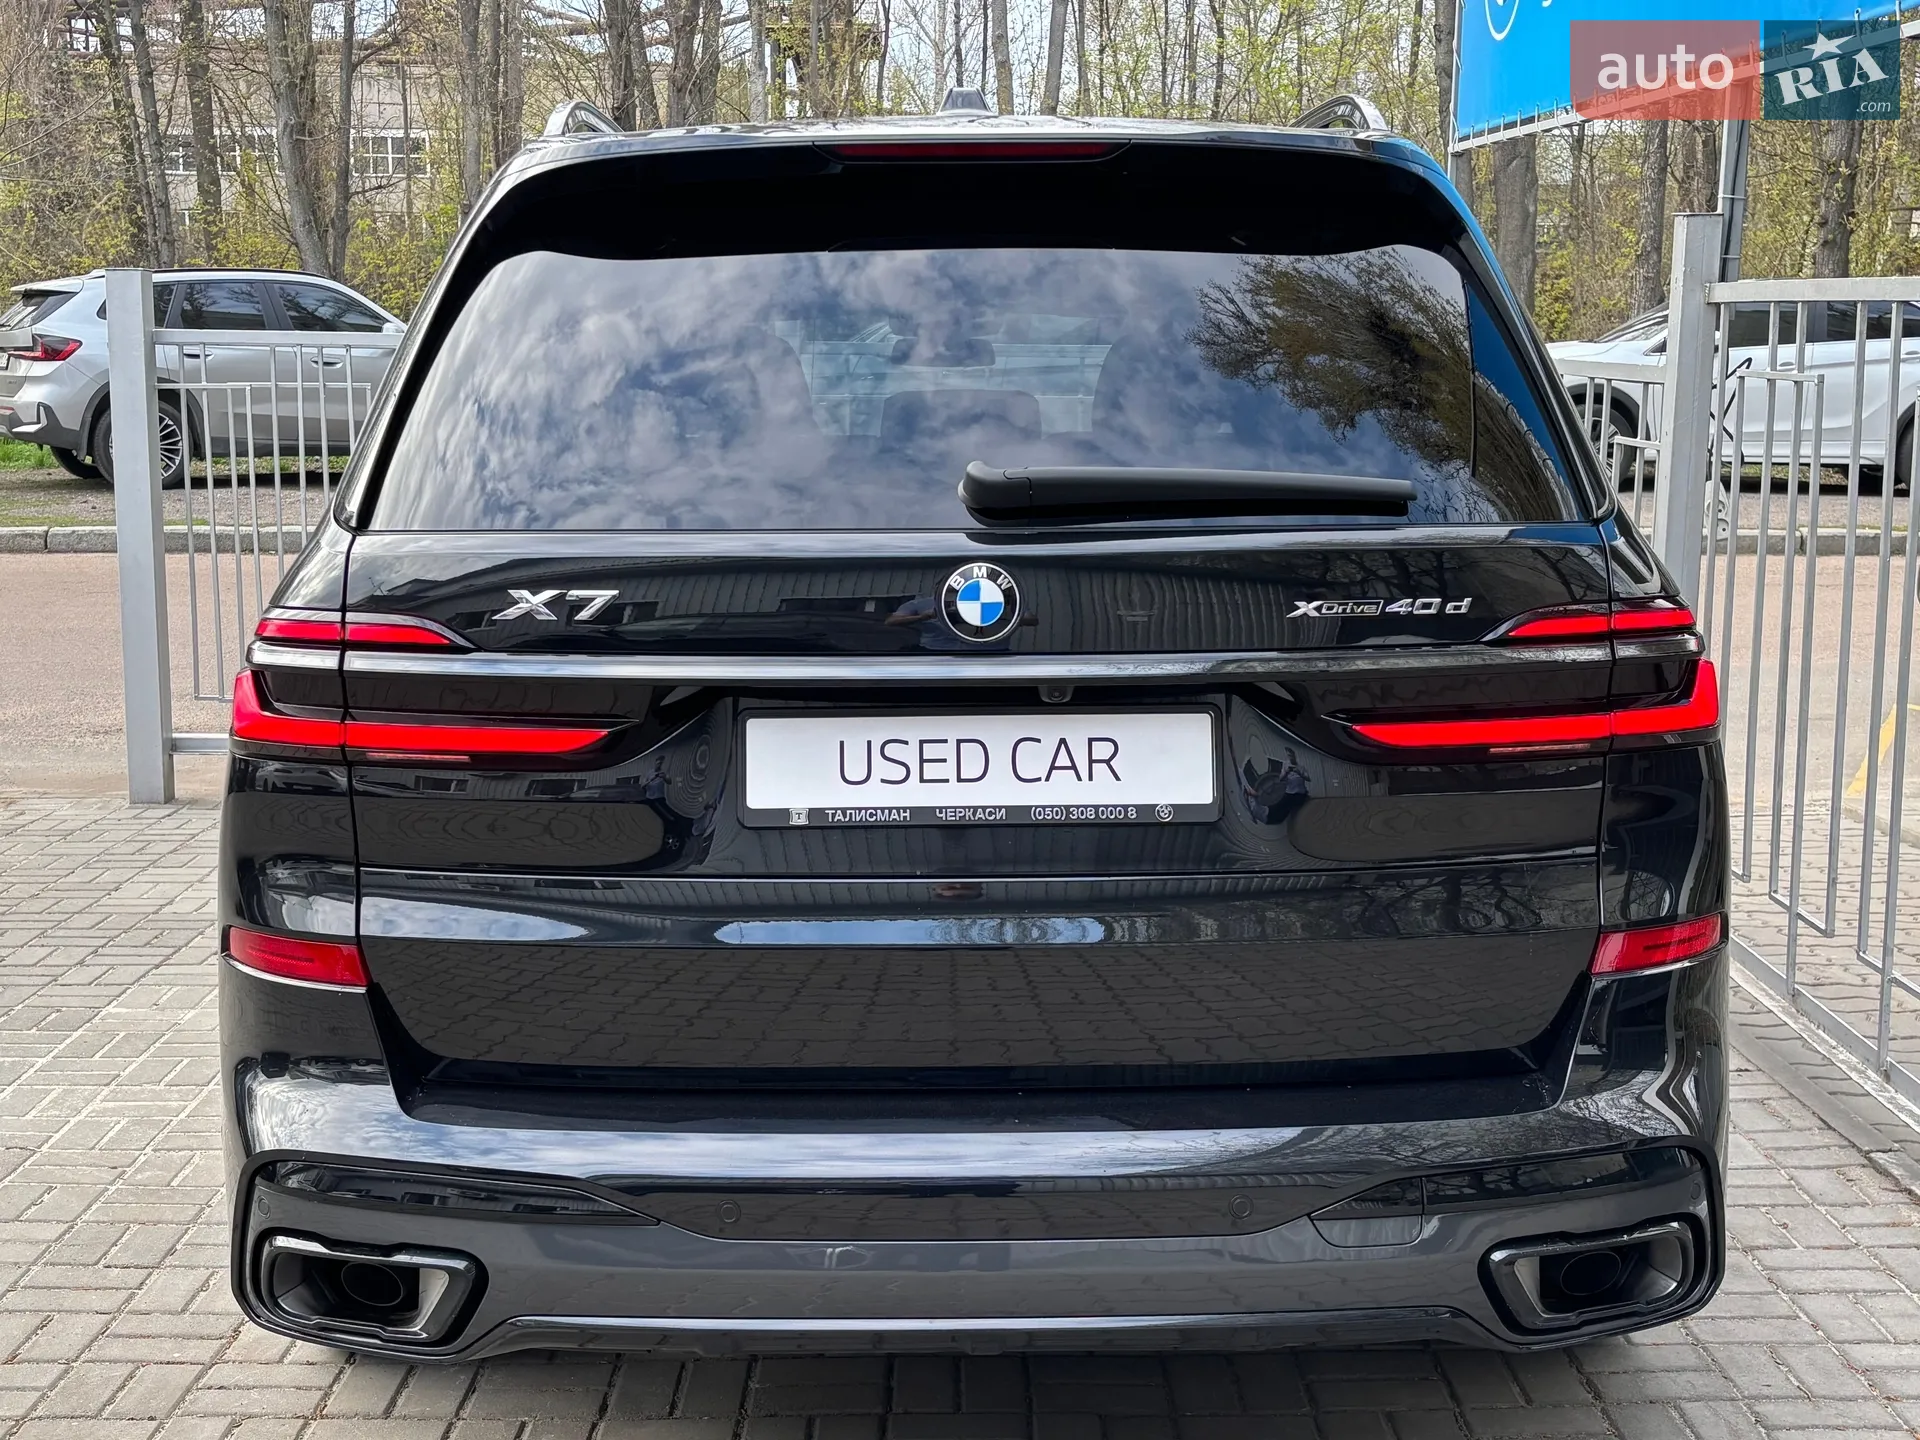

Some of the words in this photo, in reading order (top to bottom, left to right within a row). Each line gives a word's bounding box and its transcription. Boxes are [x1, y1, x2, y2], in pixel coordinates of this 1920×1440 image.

[949, 566, 1012, 590] BMW
[491, 589, 620, 621] X7
[838, 739, 990, 785] USED
[1010, 737, 1122, 782] CAR
[825, 809, 910, 822] ТАЛИСМАН
[936, 808, 1006, 821] ЧЕРКАСИ
[1030, 806, 1066, 821] (050)
[1069, 807, 1096, 819] 308
[1099, 807, 1124, 819] 000
[1127, 807, 1137, 819] 8
